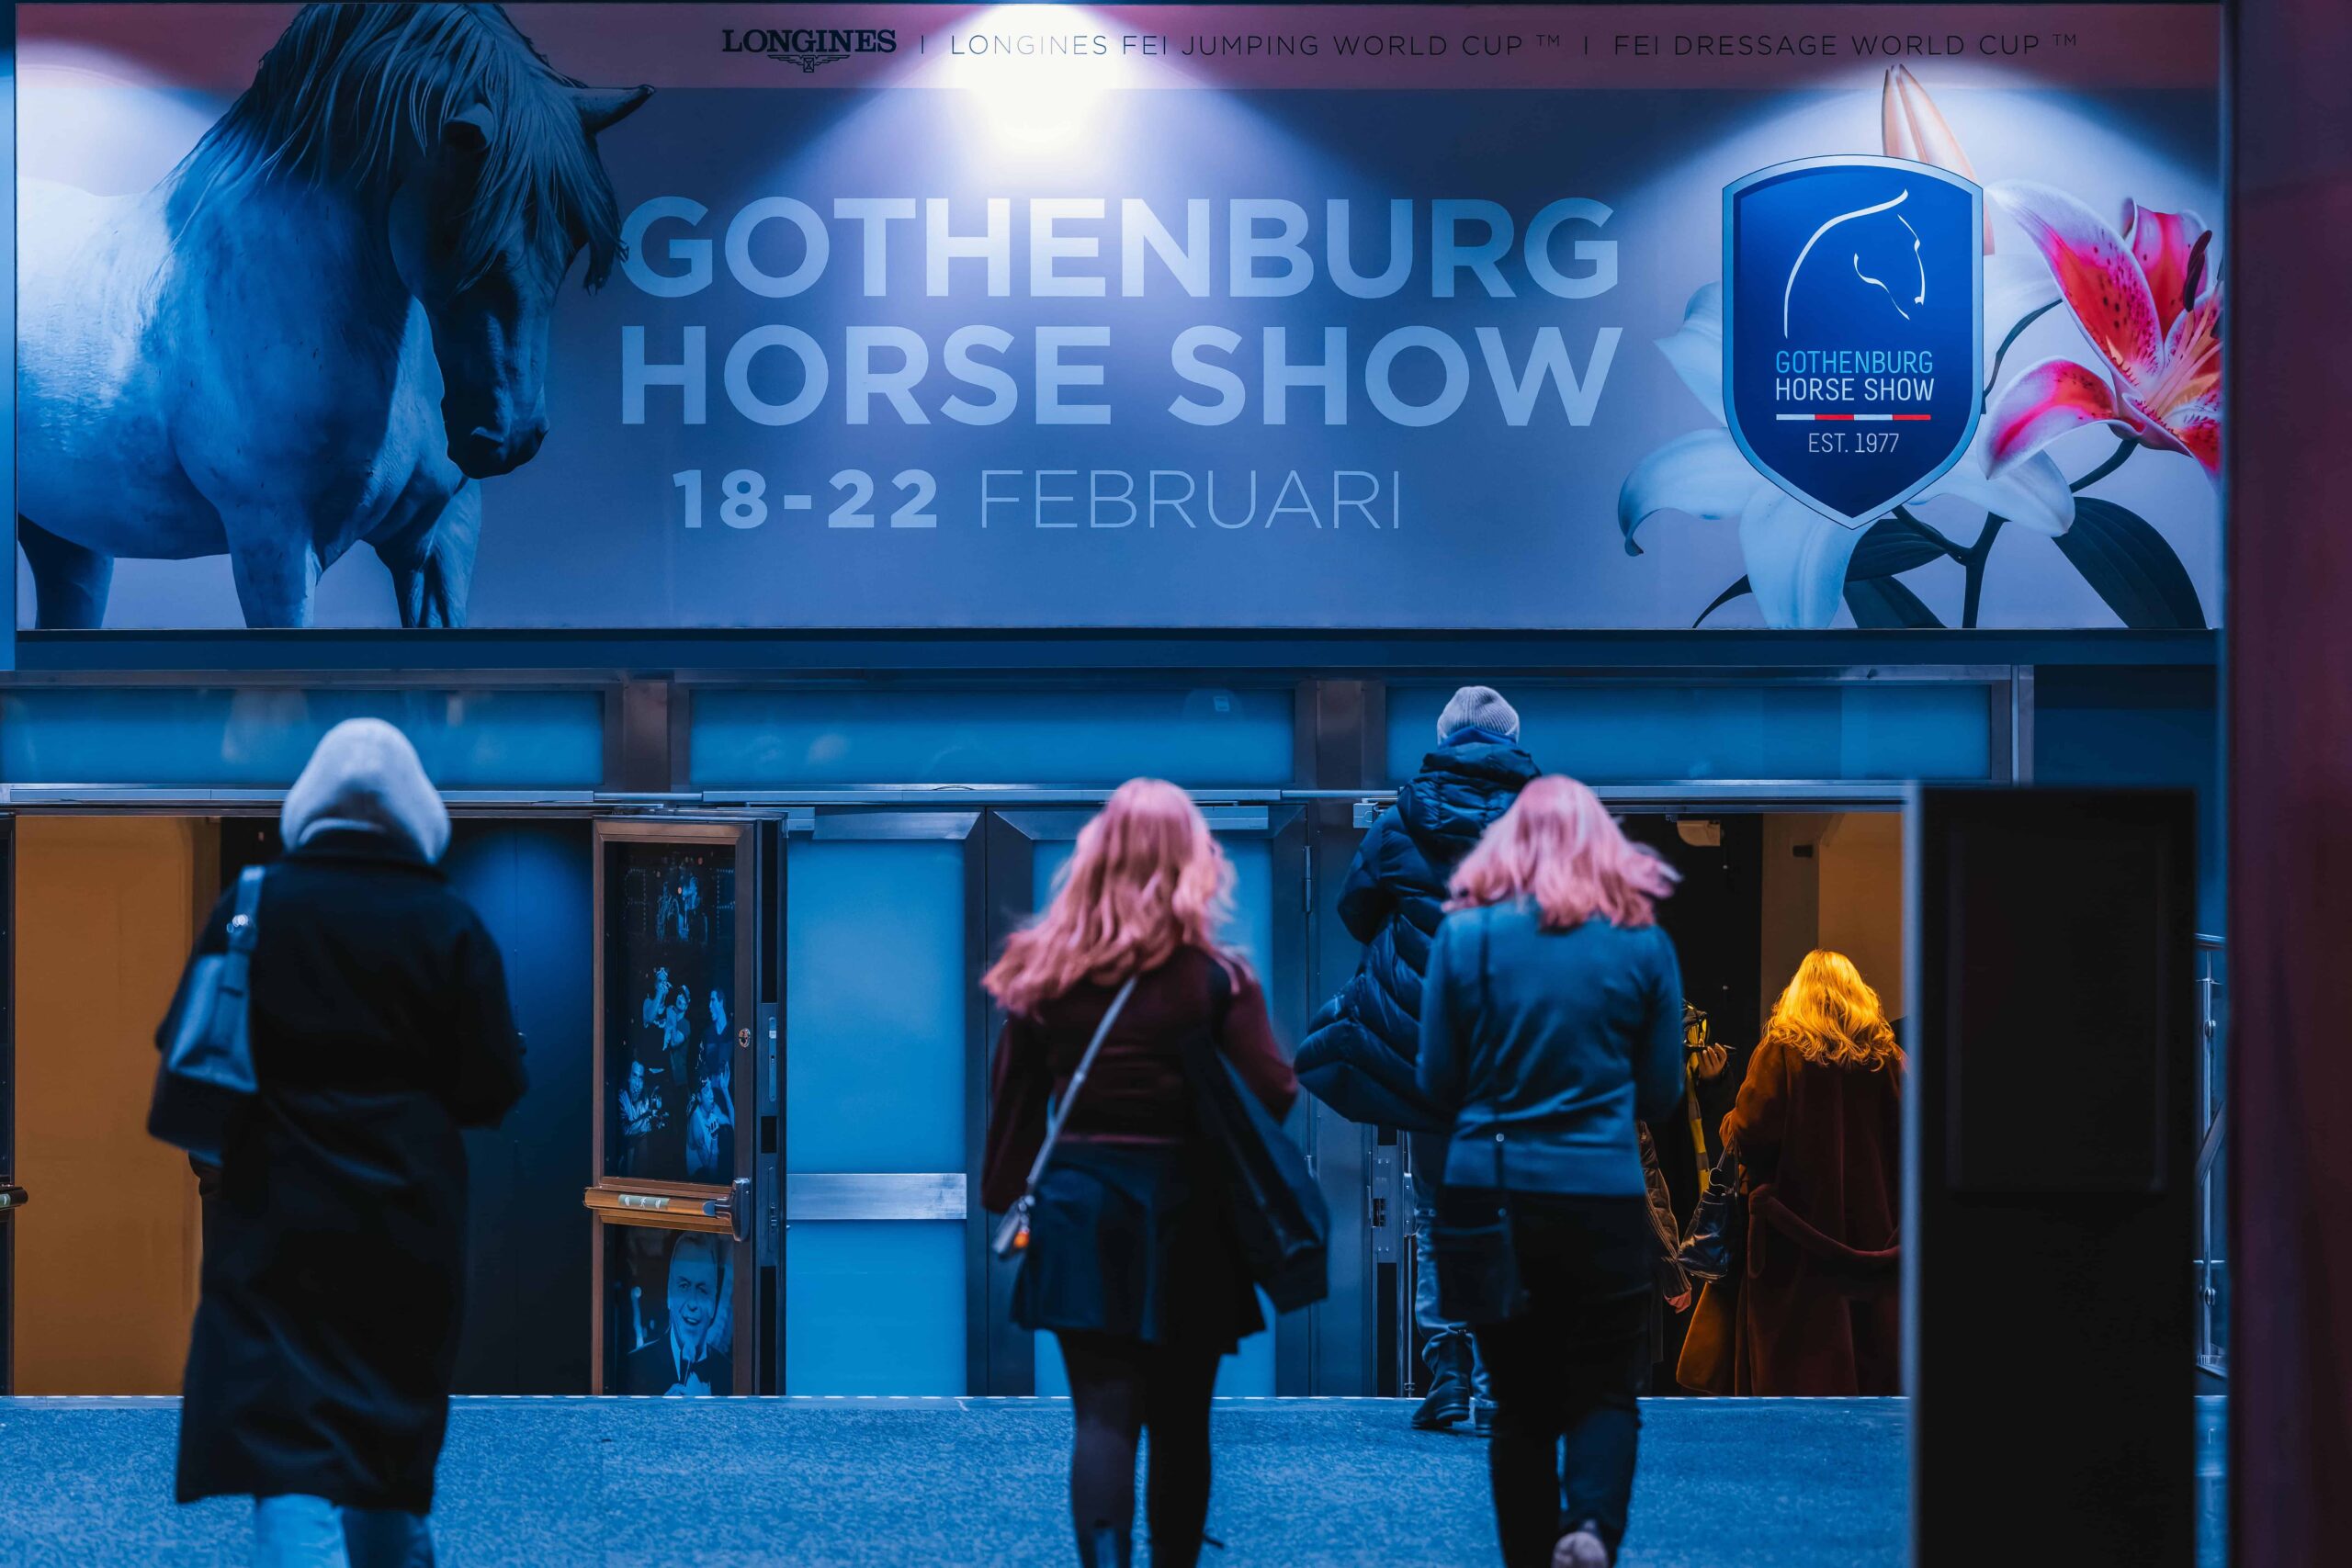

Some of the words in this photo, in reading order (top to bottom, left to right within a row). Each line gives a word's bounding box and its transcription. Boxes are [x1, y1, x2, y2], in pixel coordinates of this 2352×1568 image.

[722, 28, 897, 53] LONGINES
[952, 35, 1107, 55] LONGINES
[1123, 35, 1166, 55] FEI
[1182, 35, 1317, 56] JUMPING
[1333, 35, 1447, 56] WORLD
[1462, 35, 1522, 56] CUP
[1614, 35, 1658, 56] FEI
[1675, 35, 1837, 56] DRESSAGE
[1851, 35, 1964, 56] WORLD
[1979, 35, 2039, 55] CUP
[621, 196, 1618, 299] GOTHENBURG
[1775, 351, 1933, 374] GOTHENBURG
[621, 324, 1112, 427] HORSE
[1167, 324, 1623, 427] SHOW
[1775, 378, 1855, 400] HORSE
[1864, 378, 1934, 400] SHOW
[1808, 433, 1849, 453] EST.
[1854, 433, 1899, 453] 1977
[672, 468, 938, 530] 18-22
[980, 469, 1400, 530] FEBRUARI
